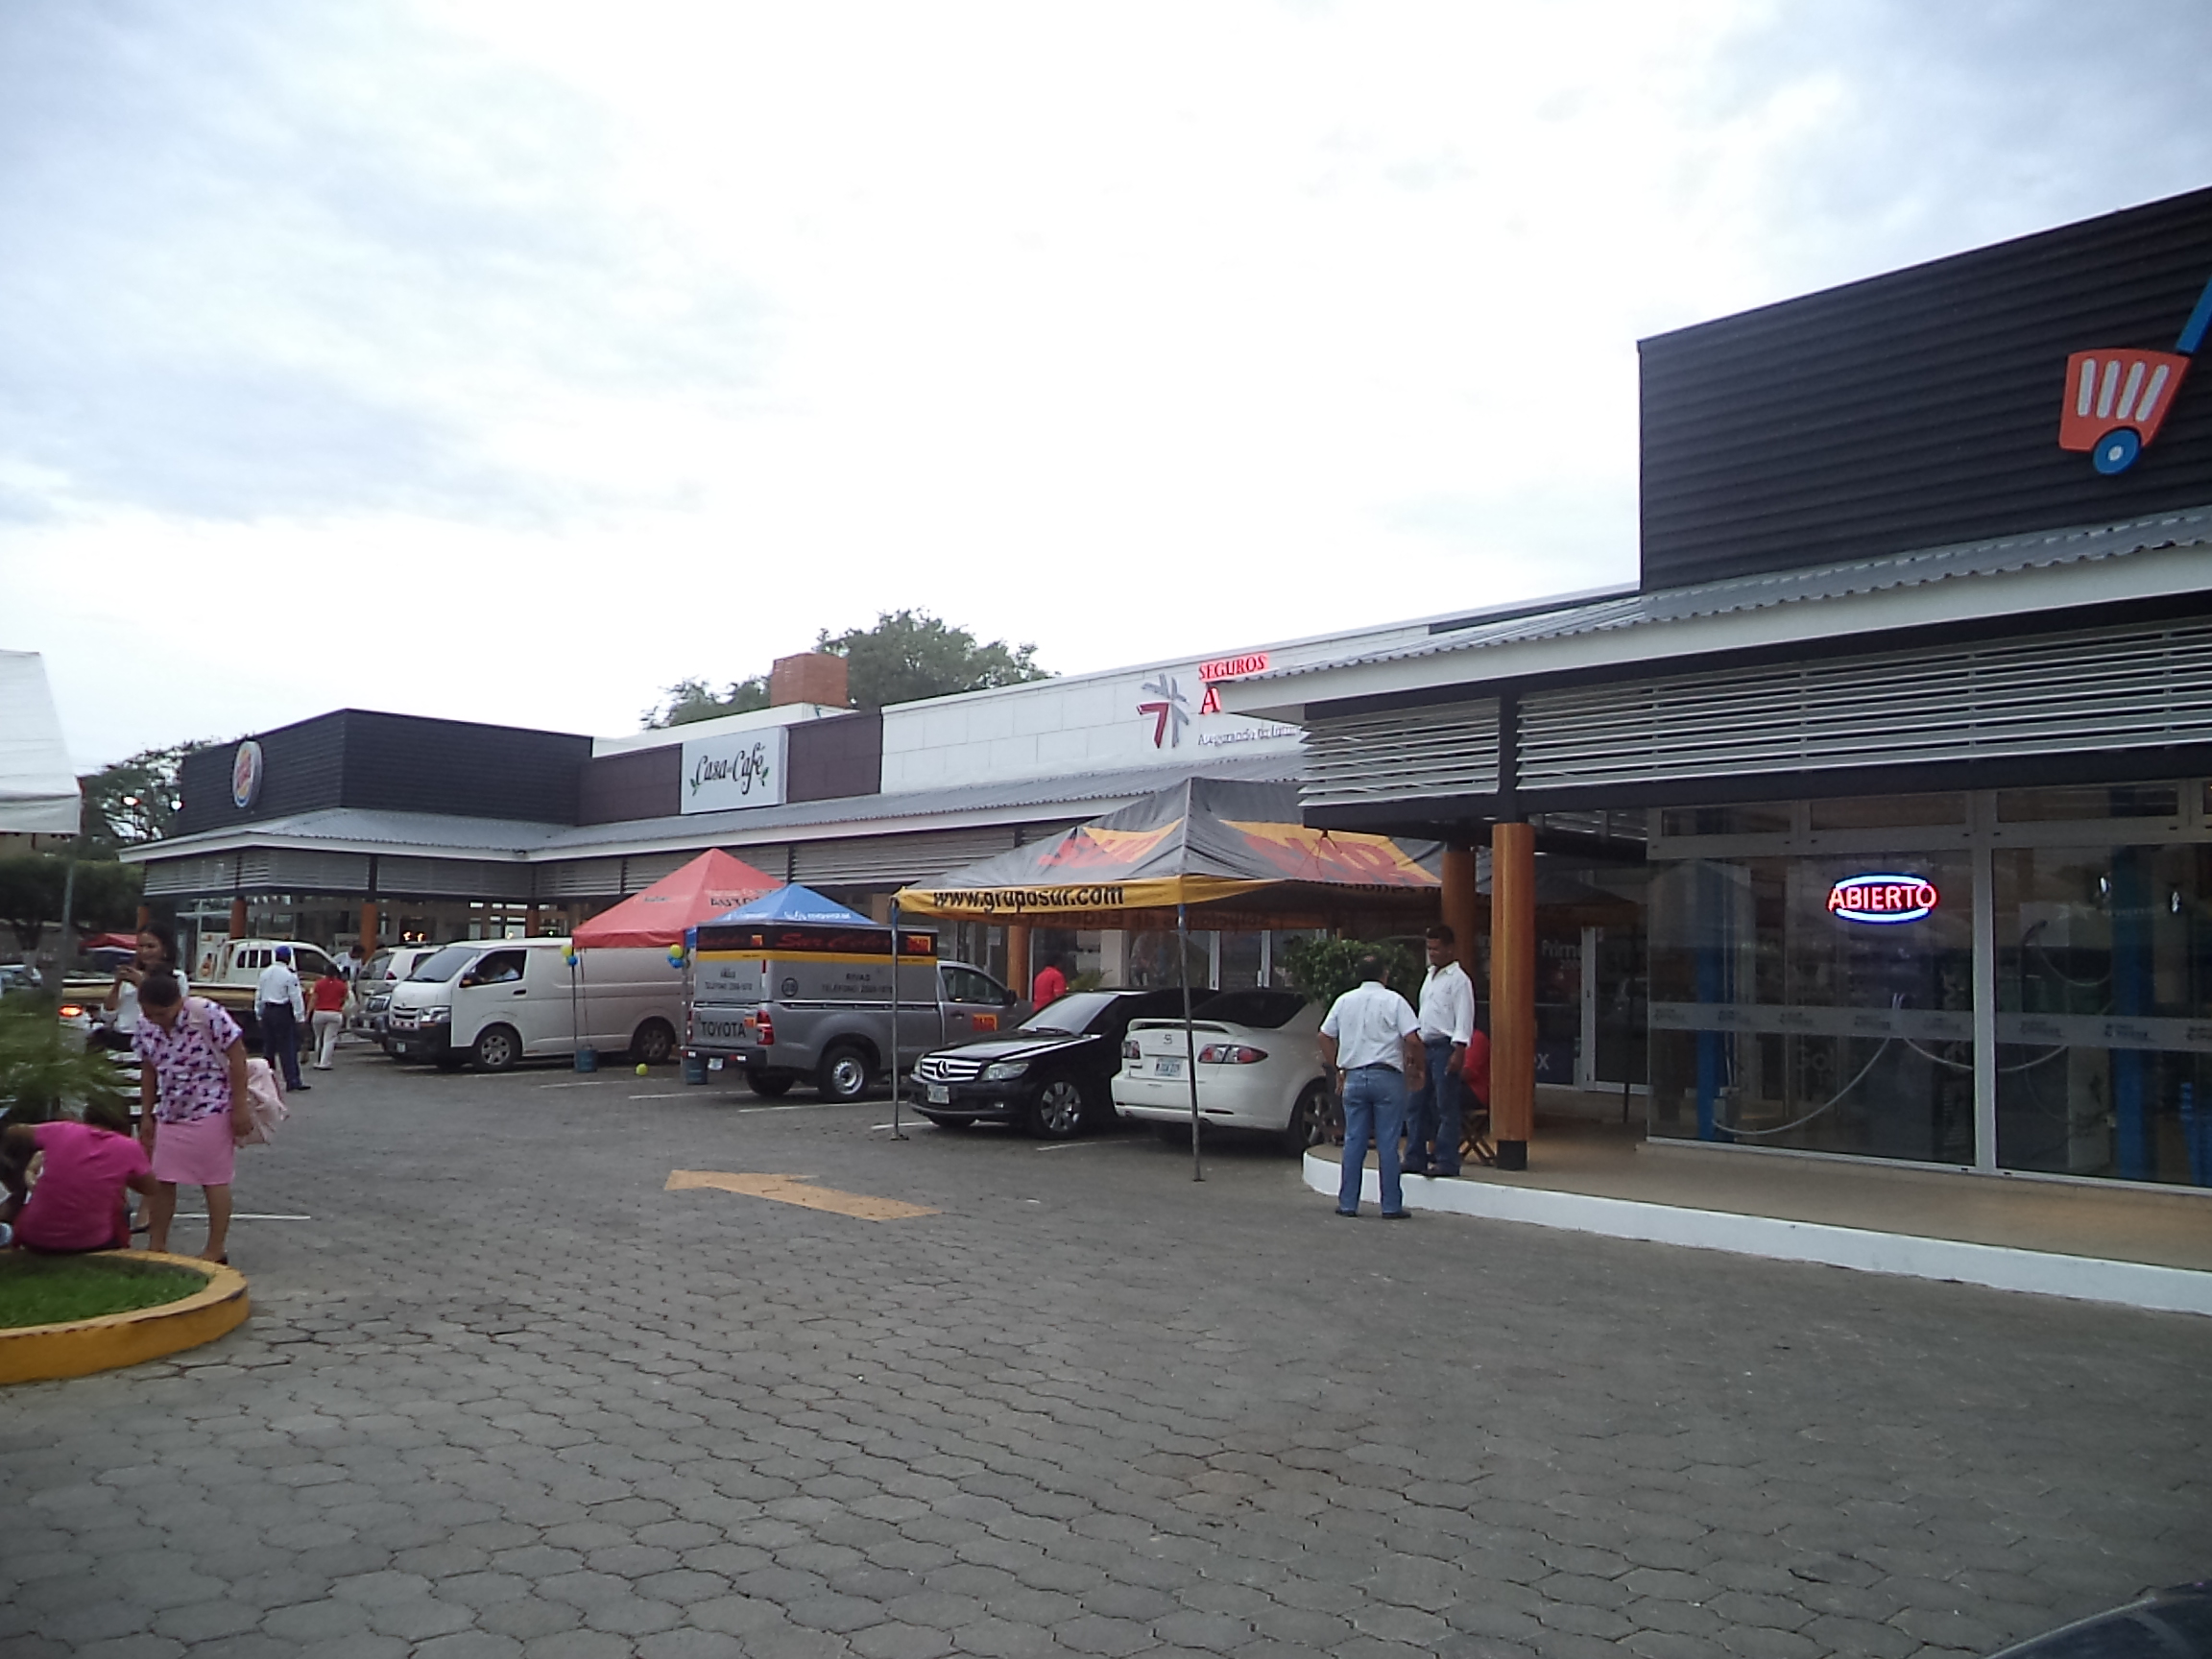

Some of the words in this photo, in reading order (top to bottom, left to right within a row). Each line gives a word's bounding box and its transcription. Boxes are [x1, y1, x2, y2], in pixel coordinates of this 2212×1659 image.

[1199, 654, 1268, 680] SEGUROS
[696, 756, 727, 785] Casa
[733, 742, 765, 795] Café
[932, 885, 1124, 912] www.gruposur.com
[1828, 885, 1937, 911] ABIERTO
[701, 1022, 747, 1038] TOYOTA
